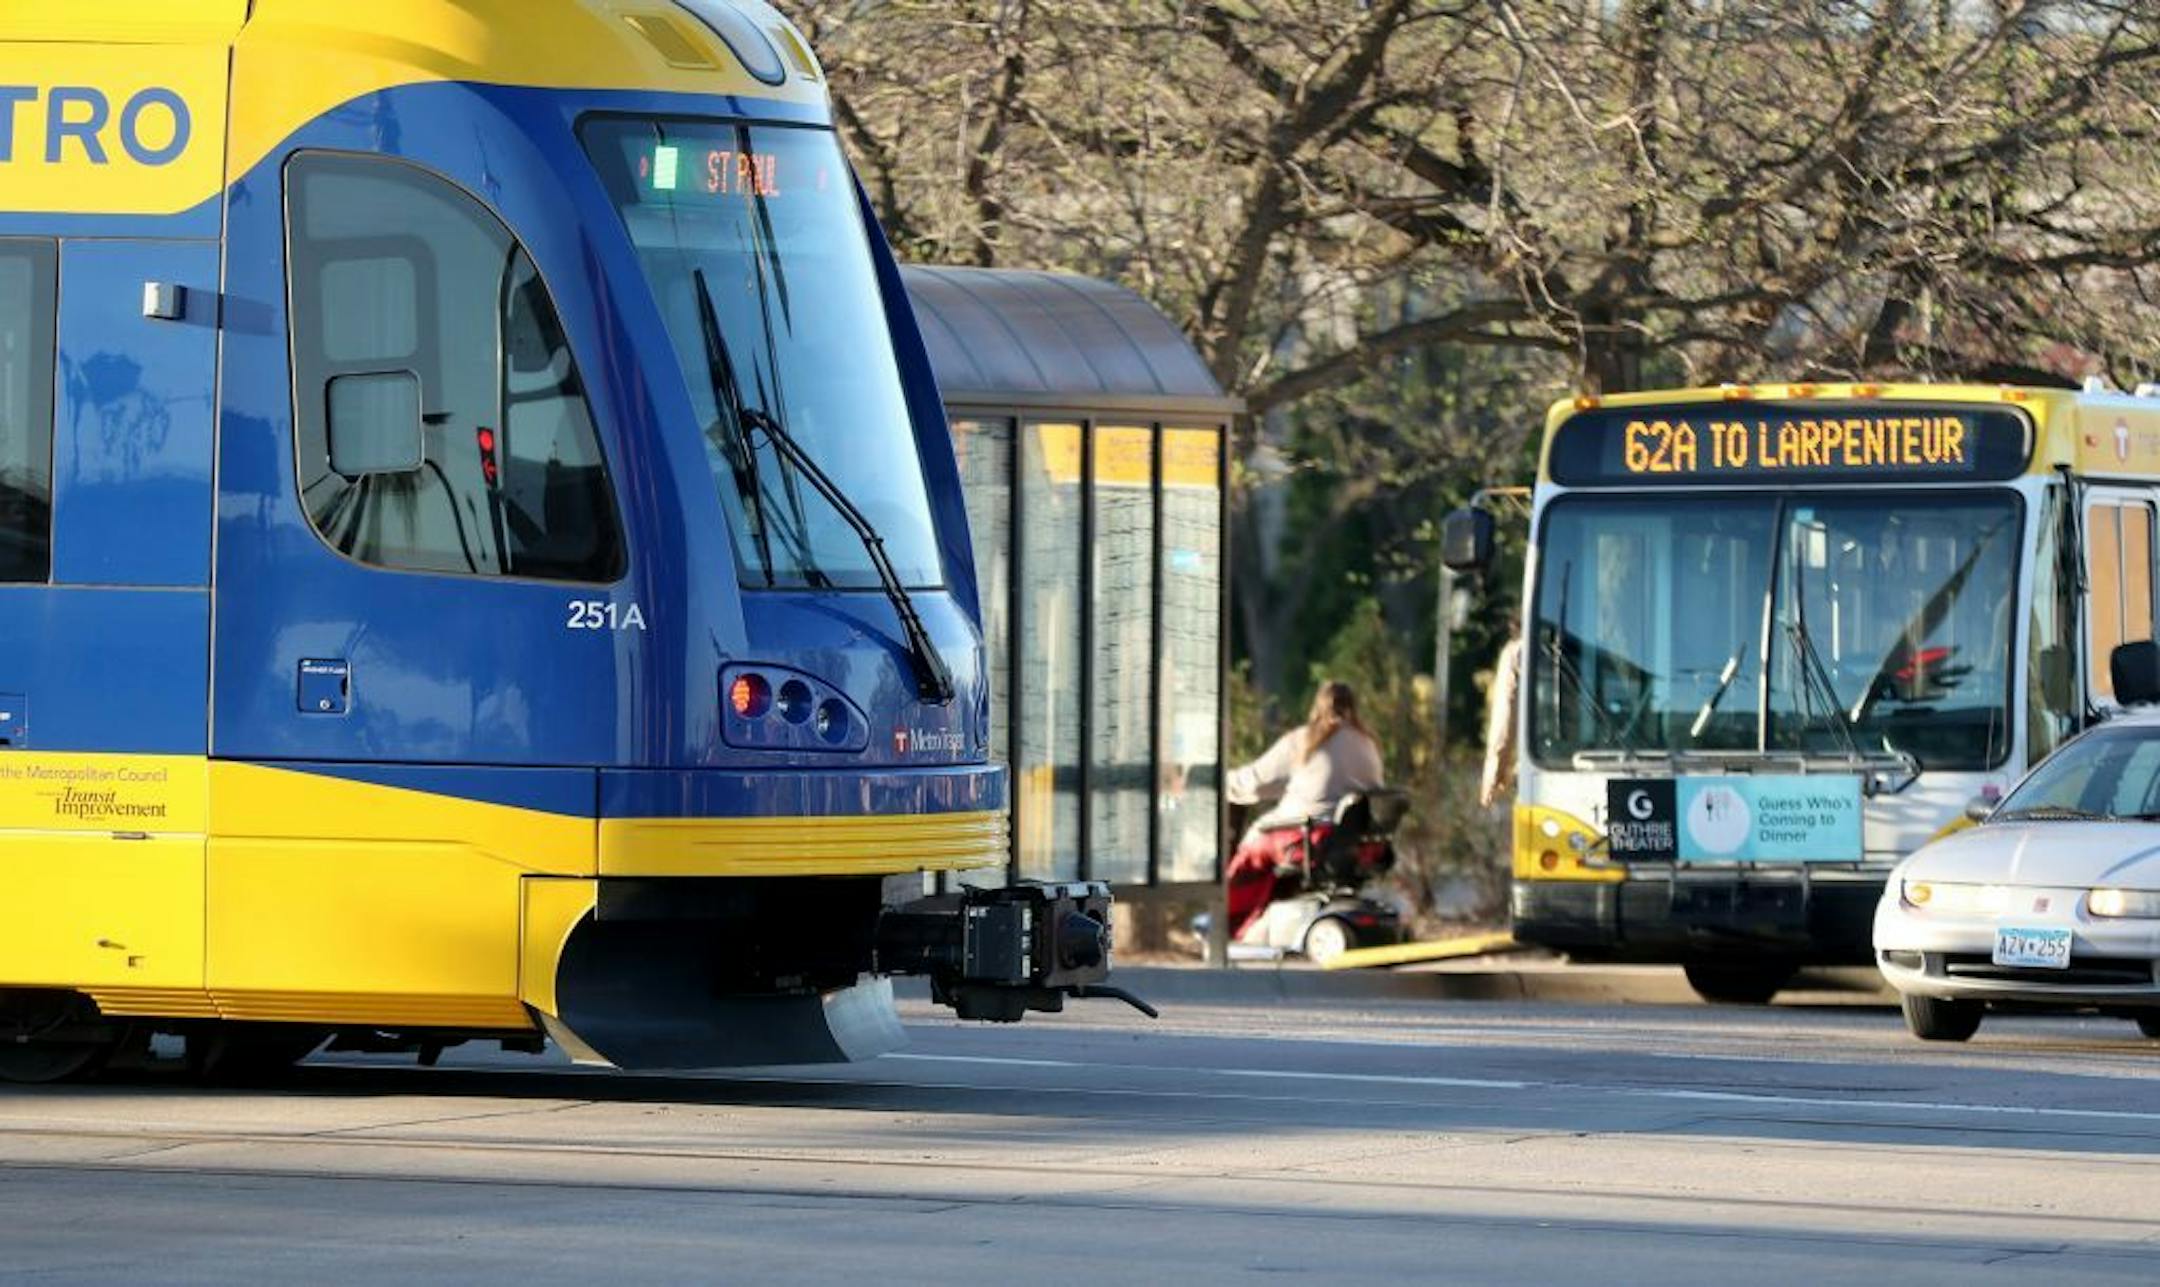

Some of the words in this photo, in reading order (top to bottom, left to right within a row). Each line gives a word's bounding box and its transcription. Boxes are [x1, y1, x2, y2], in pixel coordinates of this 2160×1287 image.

[707, 151, 730, 193] ST
[1625, 421, 1697, 472] 62A
[1710, 422, 1748, 467] TO
[1759, 417, 1964, 468] LARPENTEUR
[566, 600, 647, 630] 251A
[27, 765, 115, 784] Metropolitan
[118, 767, 168, 781] Council
[63, 787, 117, 803] Transit
[1759, 797, 1802, 810] Guess
[1807, 796, 1853, 810] Who's
[56, 798, 167, 819] Improvement
[1759, 813, 1816, 828] Coming
[1821, 814, 1836, 826] to
[1759, 830, 1807, 843] Dinner
